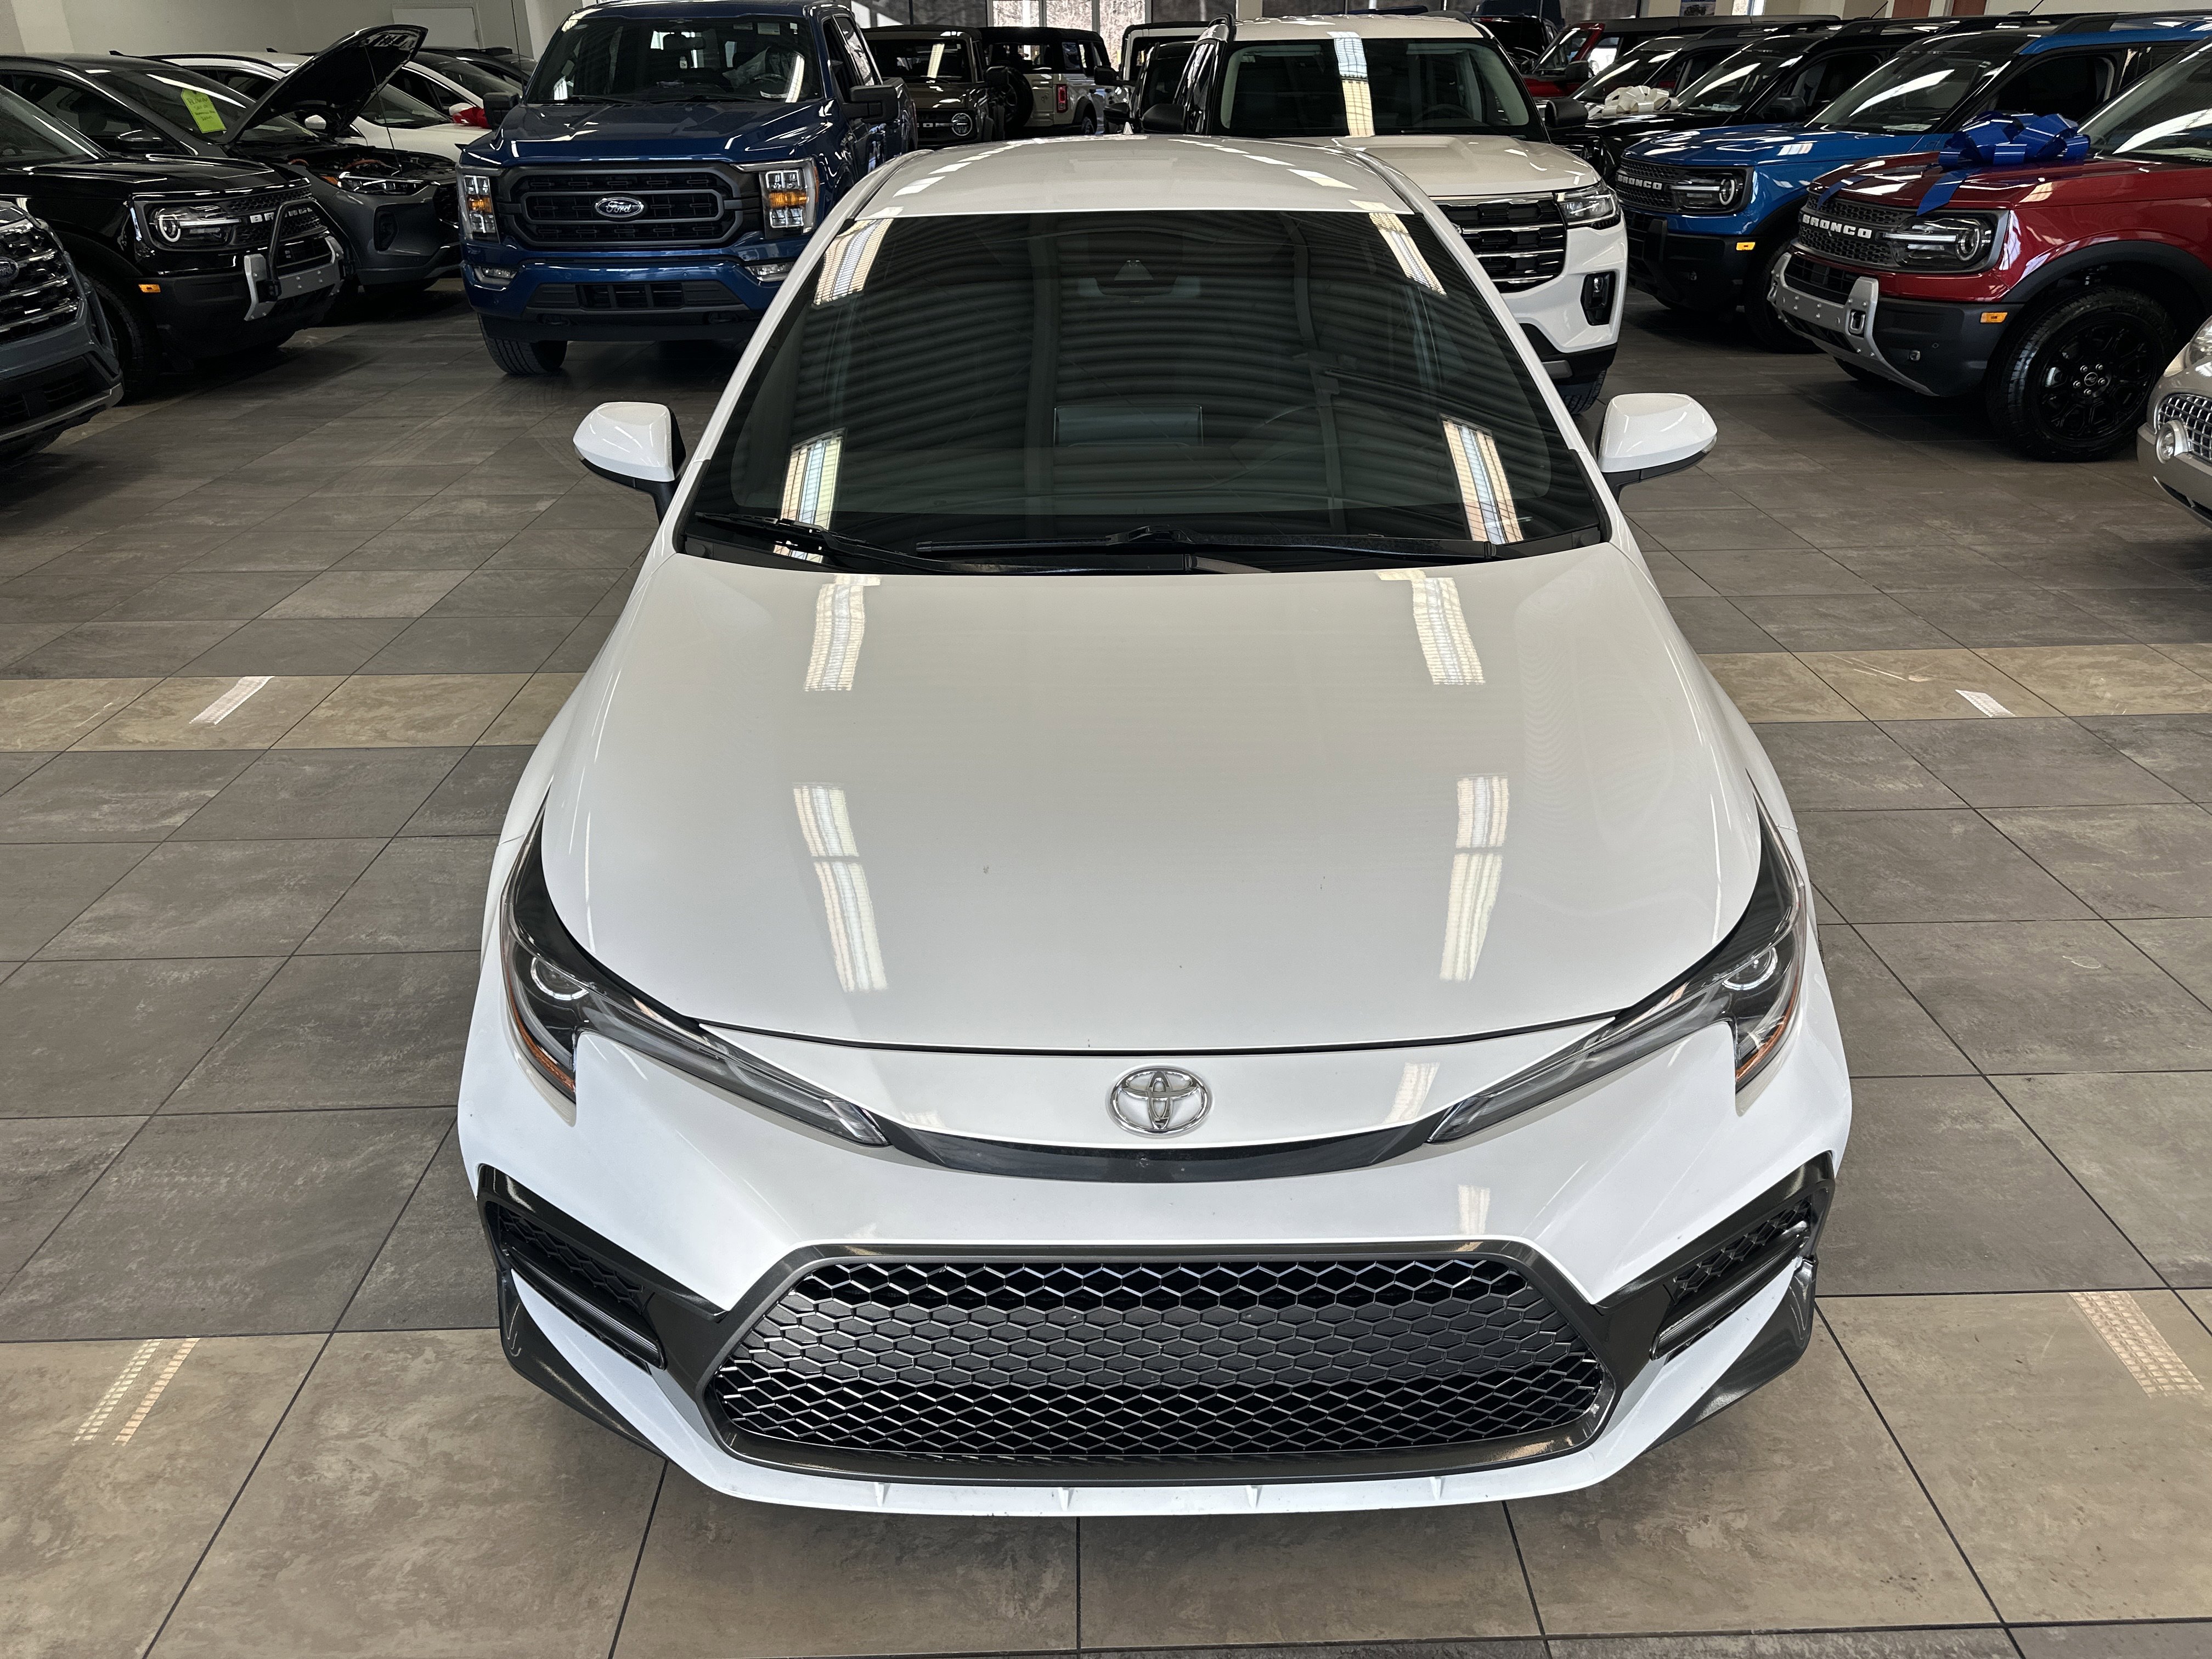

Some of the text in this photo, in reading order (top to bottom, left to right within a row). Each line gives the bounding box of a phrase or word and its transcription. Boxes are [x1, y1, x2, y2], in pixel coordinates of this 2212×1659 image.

[1618, 174, 1662, 190] BRONCO
[606, 201, 631, 213] Ford
[1802, 214, 1872, 239] BRONCO
